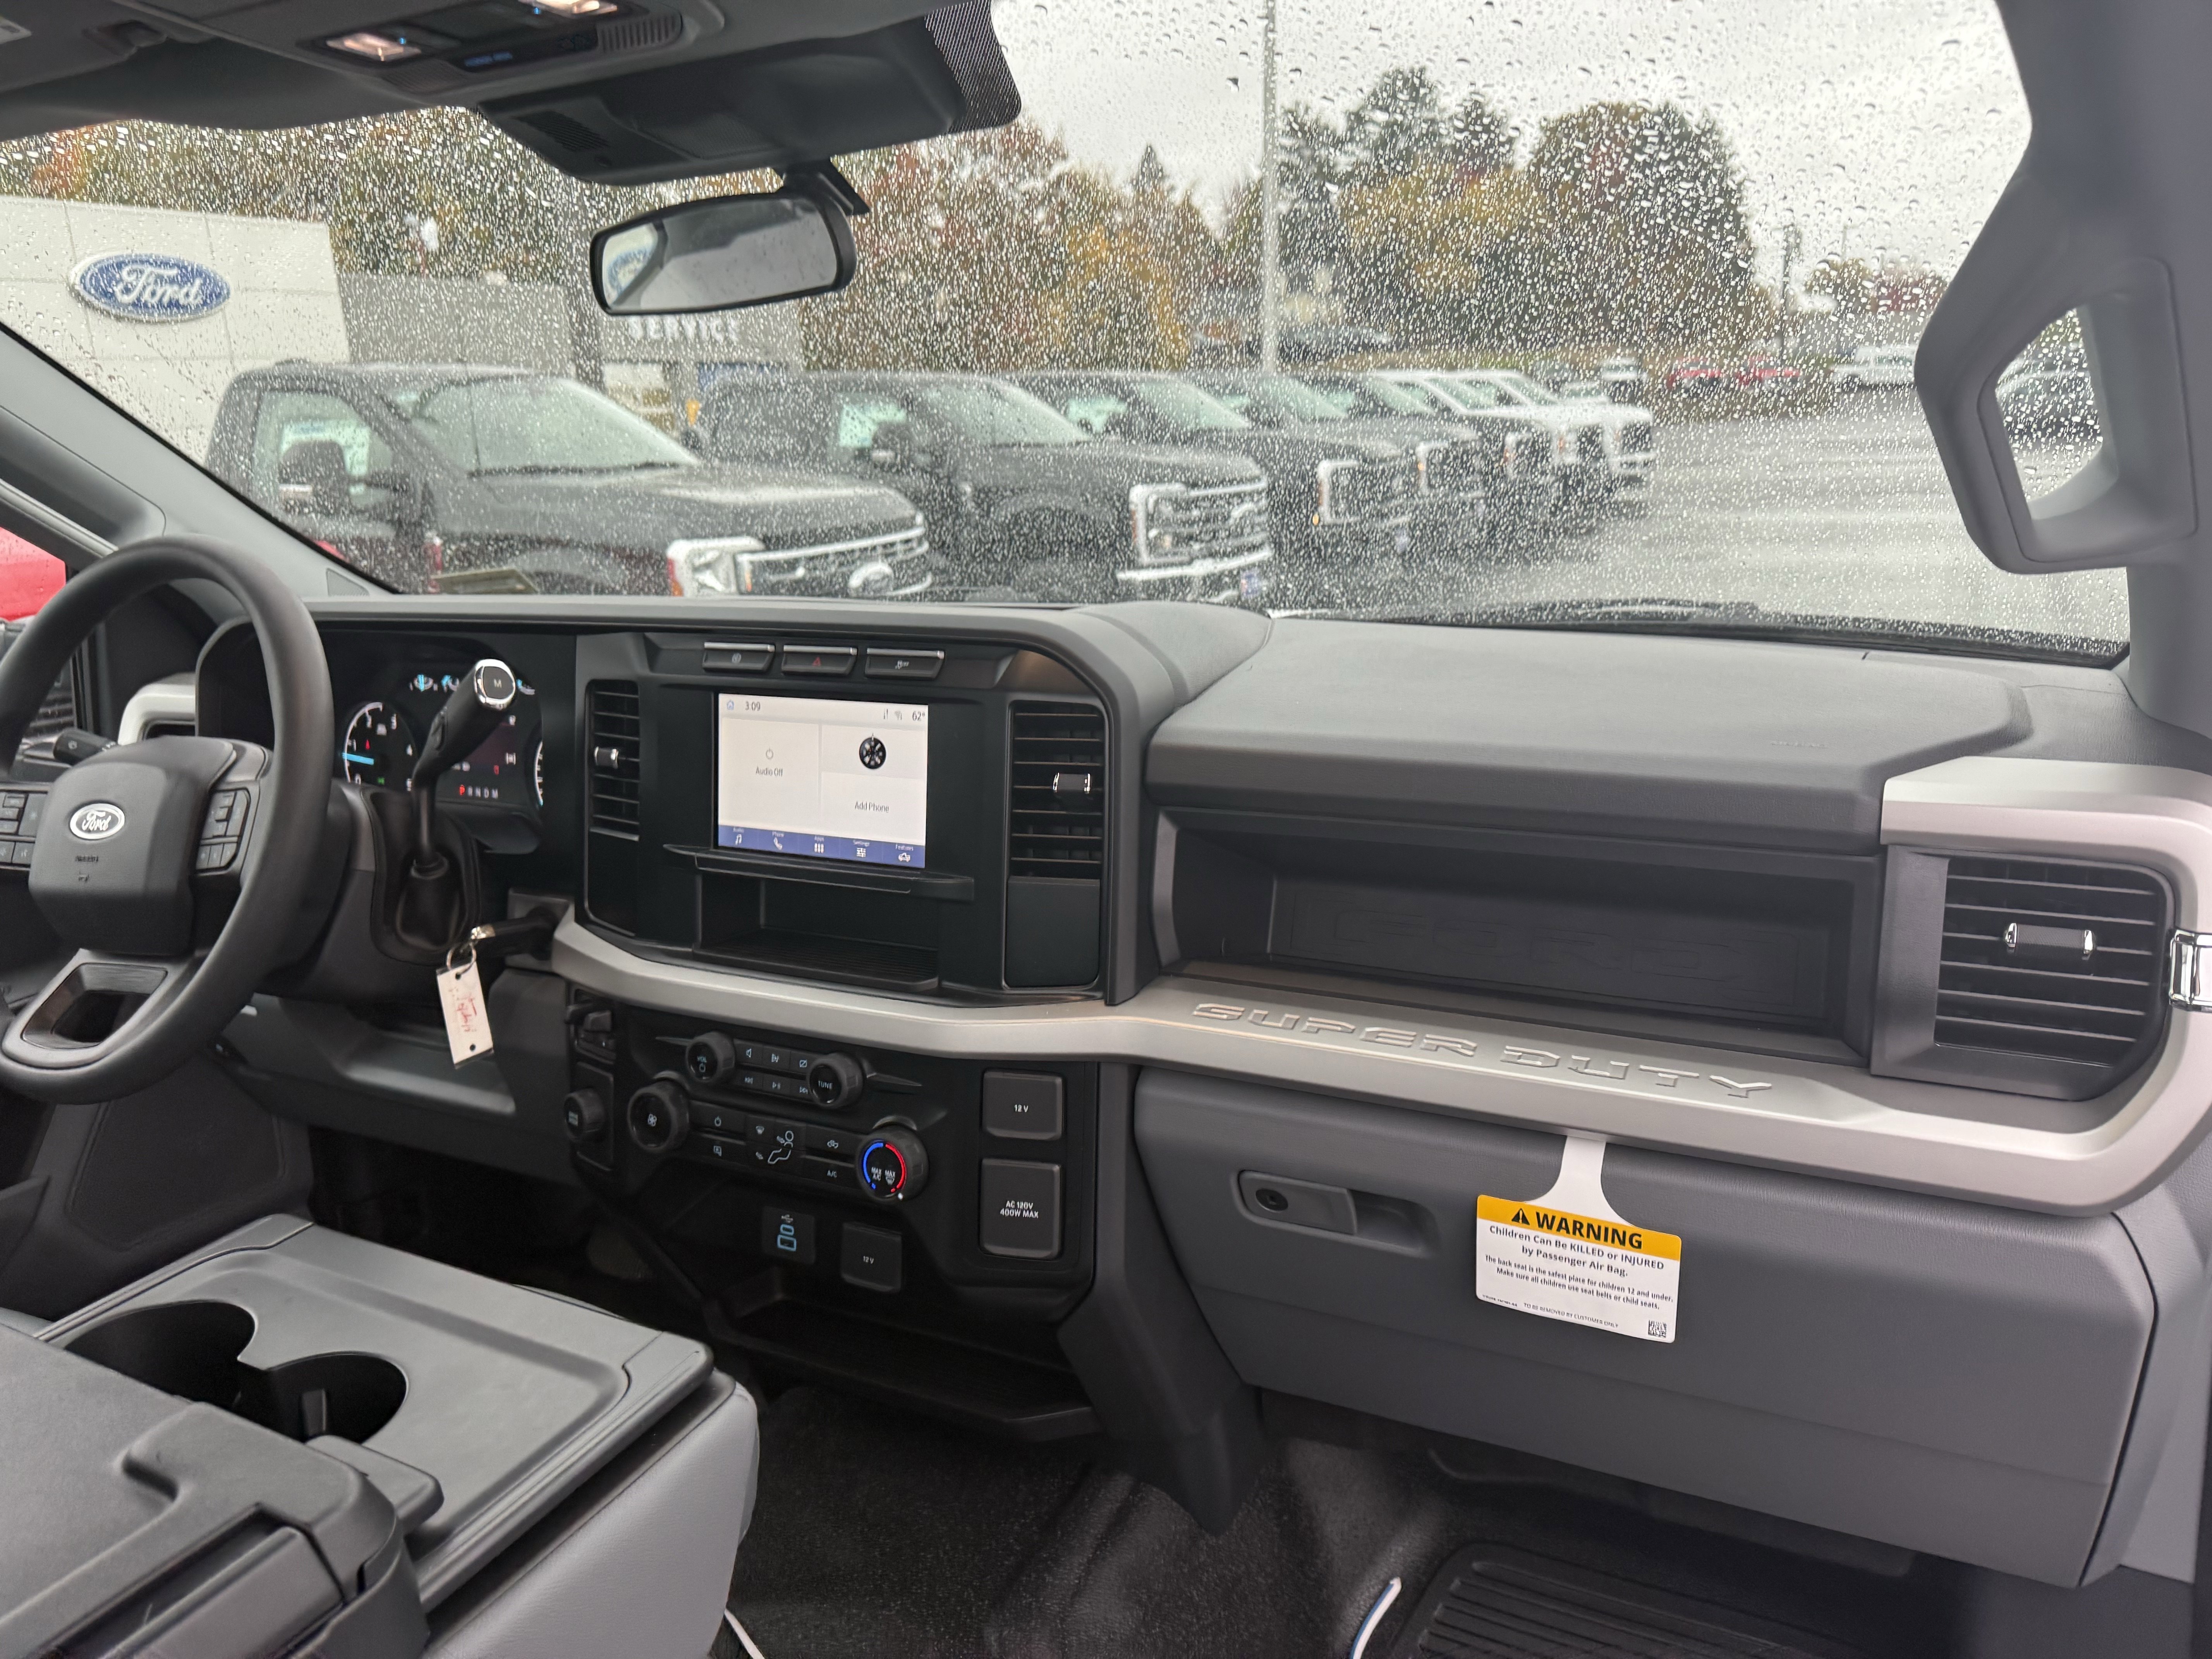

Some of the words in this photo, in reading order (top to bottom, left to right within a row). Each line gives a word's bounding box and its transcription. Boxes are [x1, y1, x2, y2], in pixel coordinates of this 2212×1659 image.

[115, 264, 203, 306] Ford
[628, 315, 740, 342] SERVICE
[494, 679, 502, 688] M
[745, 701, 761, 711] 3:09
[756, 766, 773, 776] Audio
[774, 768, 783, 776] Off
[855, 801, 867, 811] Add
[869, 802, 889, 813] Phone
[82, 811, 112, 831] Ford
[1193, 1003, 1477, 1057] SUPER
[1501, 1046, 1772, 1098] DUTY
[818, 1080, 833, 1090] TUNE
[827, 1170, 837, 1178] A/C
[1000, 1208, 1021, 1217] 400W
[1023, 1209, 1039, 1219] MAX
[1536, 1211, 1642, 1249] WARNING
[1490, 1225, 1530, 1242] Children
[1534, 1235, 1552, 1247] Can
[1555, 1240, 1567, 1250] Be
[1570, 1243, 1604, 1257] KILLED
[1621, 1254, 1664, 1270] INJURED
[1522, 1245, 1534, 1257] by
[1537, 1249, 1587, 1267] Passenger
[1589, 1261, 1604, 1271] Air
[1607, 1264, 1628, 1278] Bag.
[1486, 1254, 1496, 1264] The
[1498, 1257, 1512, 1267] back
[1514, 1262, 1527, 1271] seat
[1536, 1267, 1546, 1275] the
[1548, 1270, 1567, 1281] safest
[1569, 1274, 1585, 1284] place
[1587, 1278, 1596, 1286] for
[1599, 1281, 1625, 1293] children
[1628, 1287, 1635, 1295] 12
[1652, 1293, 1673, 1303] under.
[1497, 1267, 1514, 1277] Make
[1541, 1278, 1566, 1290] children
[1581, 1287, 1594, 1296] seat
[1596, 1290, 1612, 1300] belts
[1623, 1296, 1638, 1305] child
[1640, 1300, 1659, 1310] seats.
[1540, 1307, 1565, 1316] REMOVED
[1574, 1313, 1603, 1324] CUSTOMER
